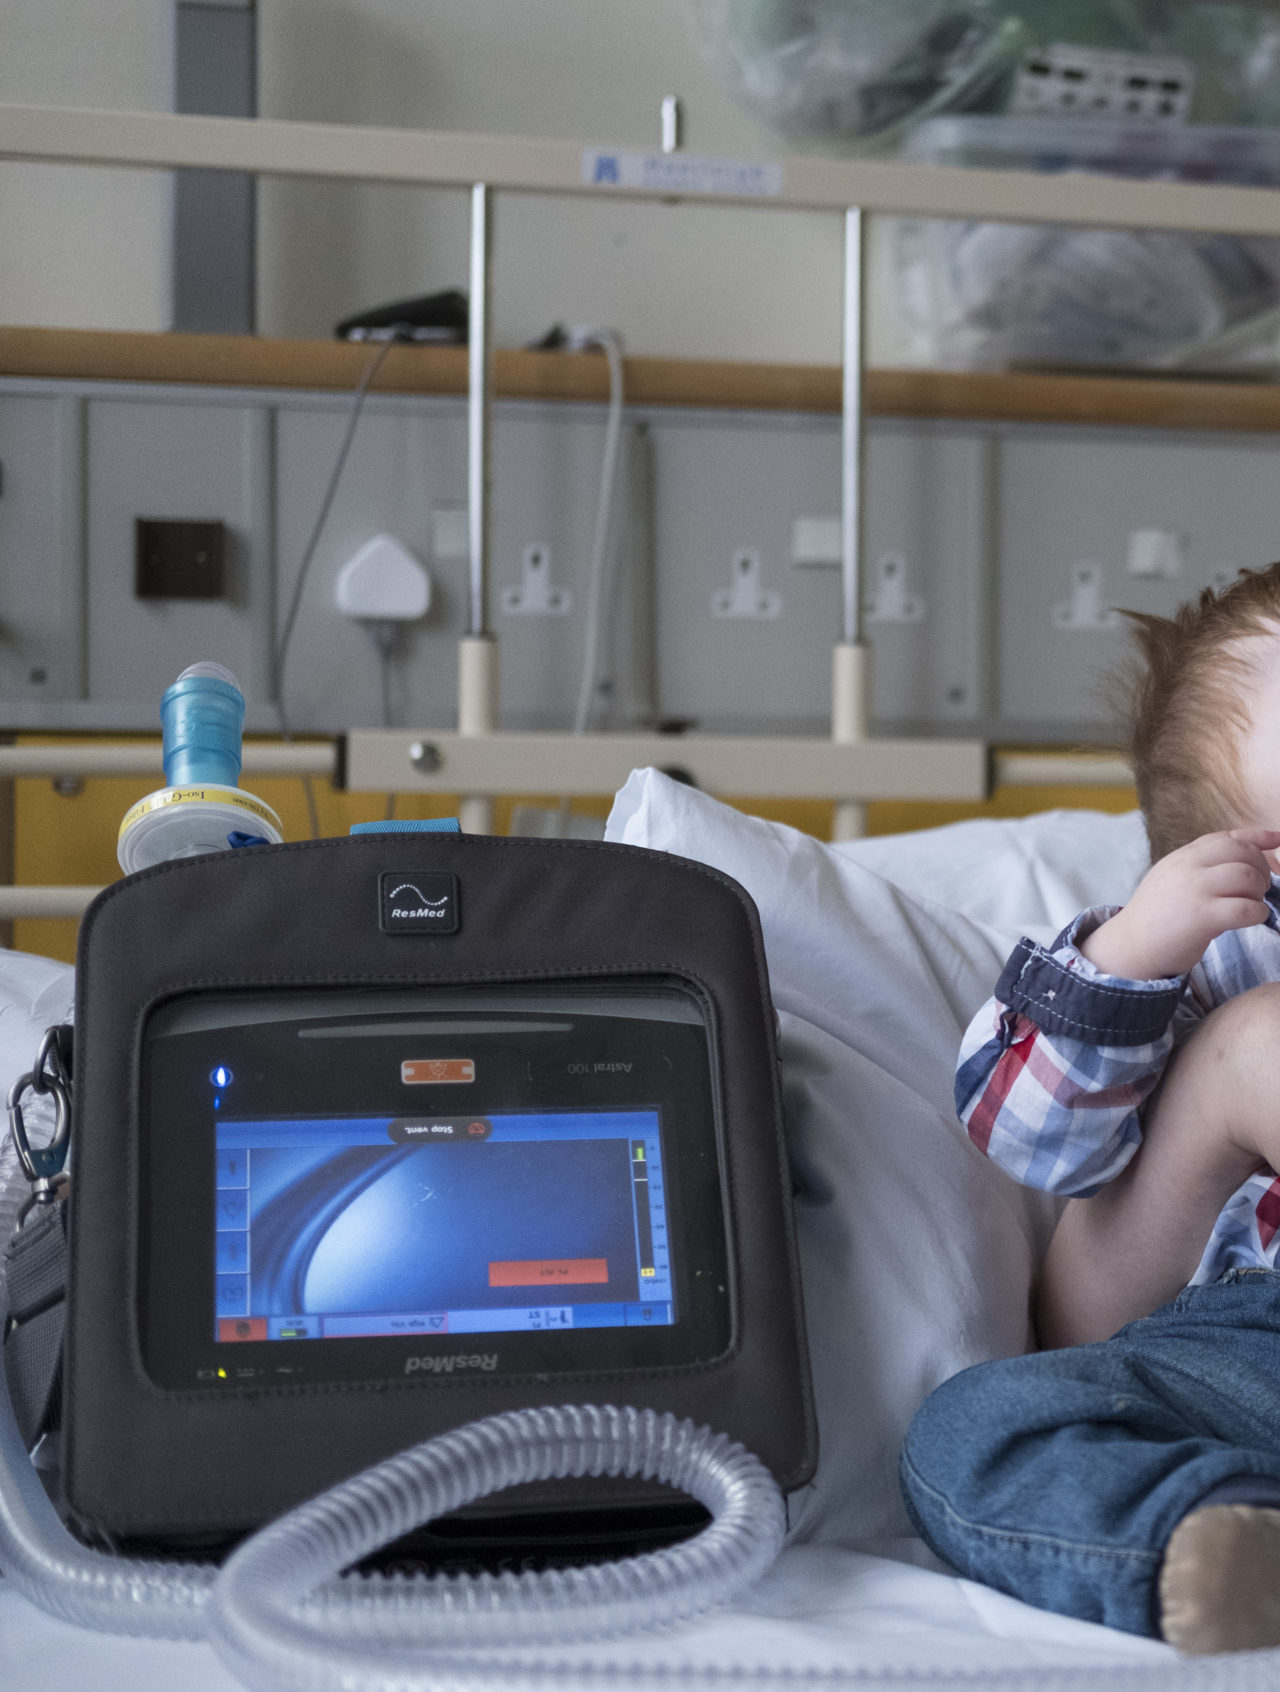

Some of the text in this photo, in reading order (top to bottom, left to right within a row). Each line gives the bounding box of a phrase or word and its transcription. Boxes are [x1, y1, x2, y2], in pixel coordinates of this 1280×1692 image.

[391, 908, 446, 918] ResMed
[567, 1062, 632, 1075] Astral 100
[404, 1124, 454, 1135] Stop vent.
[404, 1353, 499, 1375] ResMed
